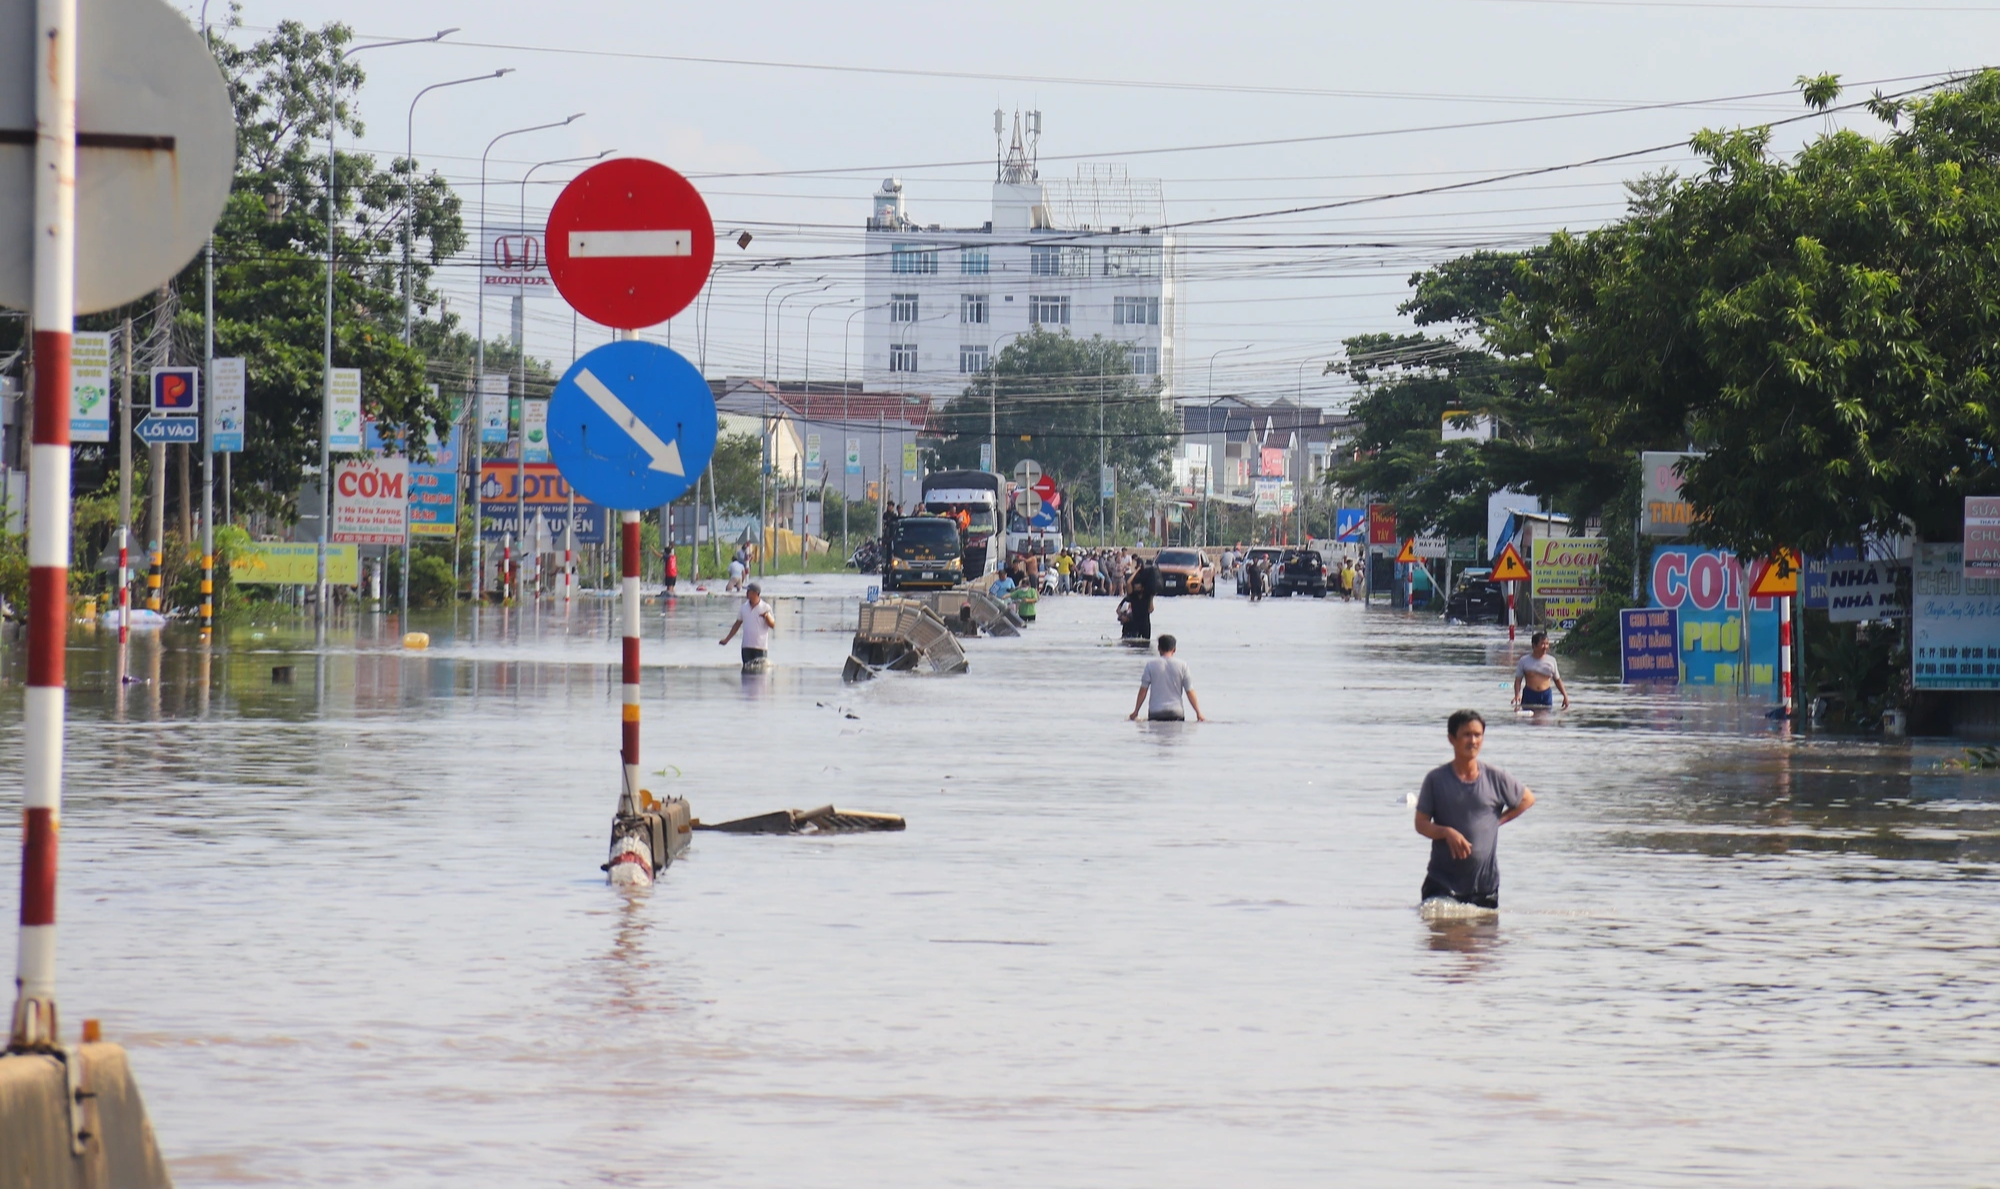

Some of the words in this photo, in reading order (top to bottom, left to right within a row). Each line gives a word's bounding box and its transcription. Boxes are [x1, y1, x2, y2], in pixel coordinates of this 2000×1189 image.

[484, 275, 549, 285] HONDA
[142, 420, 165, 437] LỐI
[168, 420, 194, 437] VÀO
[338, 467, 404, 499] CƠM
[1536, 541, 1600, 567] Loan
[1653, 552, 1775, 611] CƠM
[1917, 566, 1961, 596] CHÂU
[1629, 614, 1647, 628] CHO
[1683, 614, 1742, 652] PHỞ
